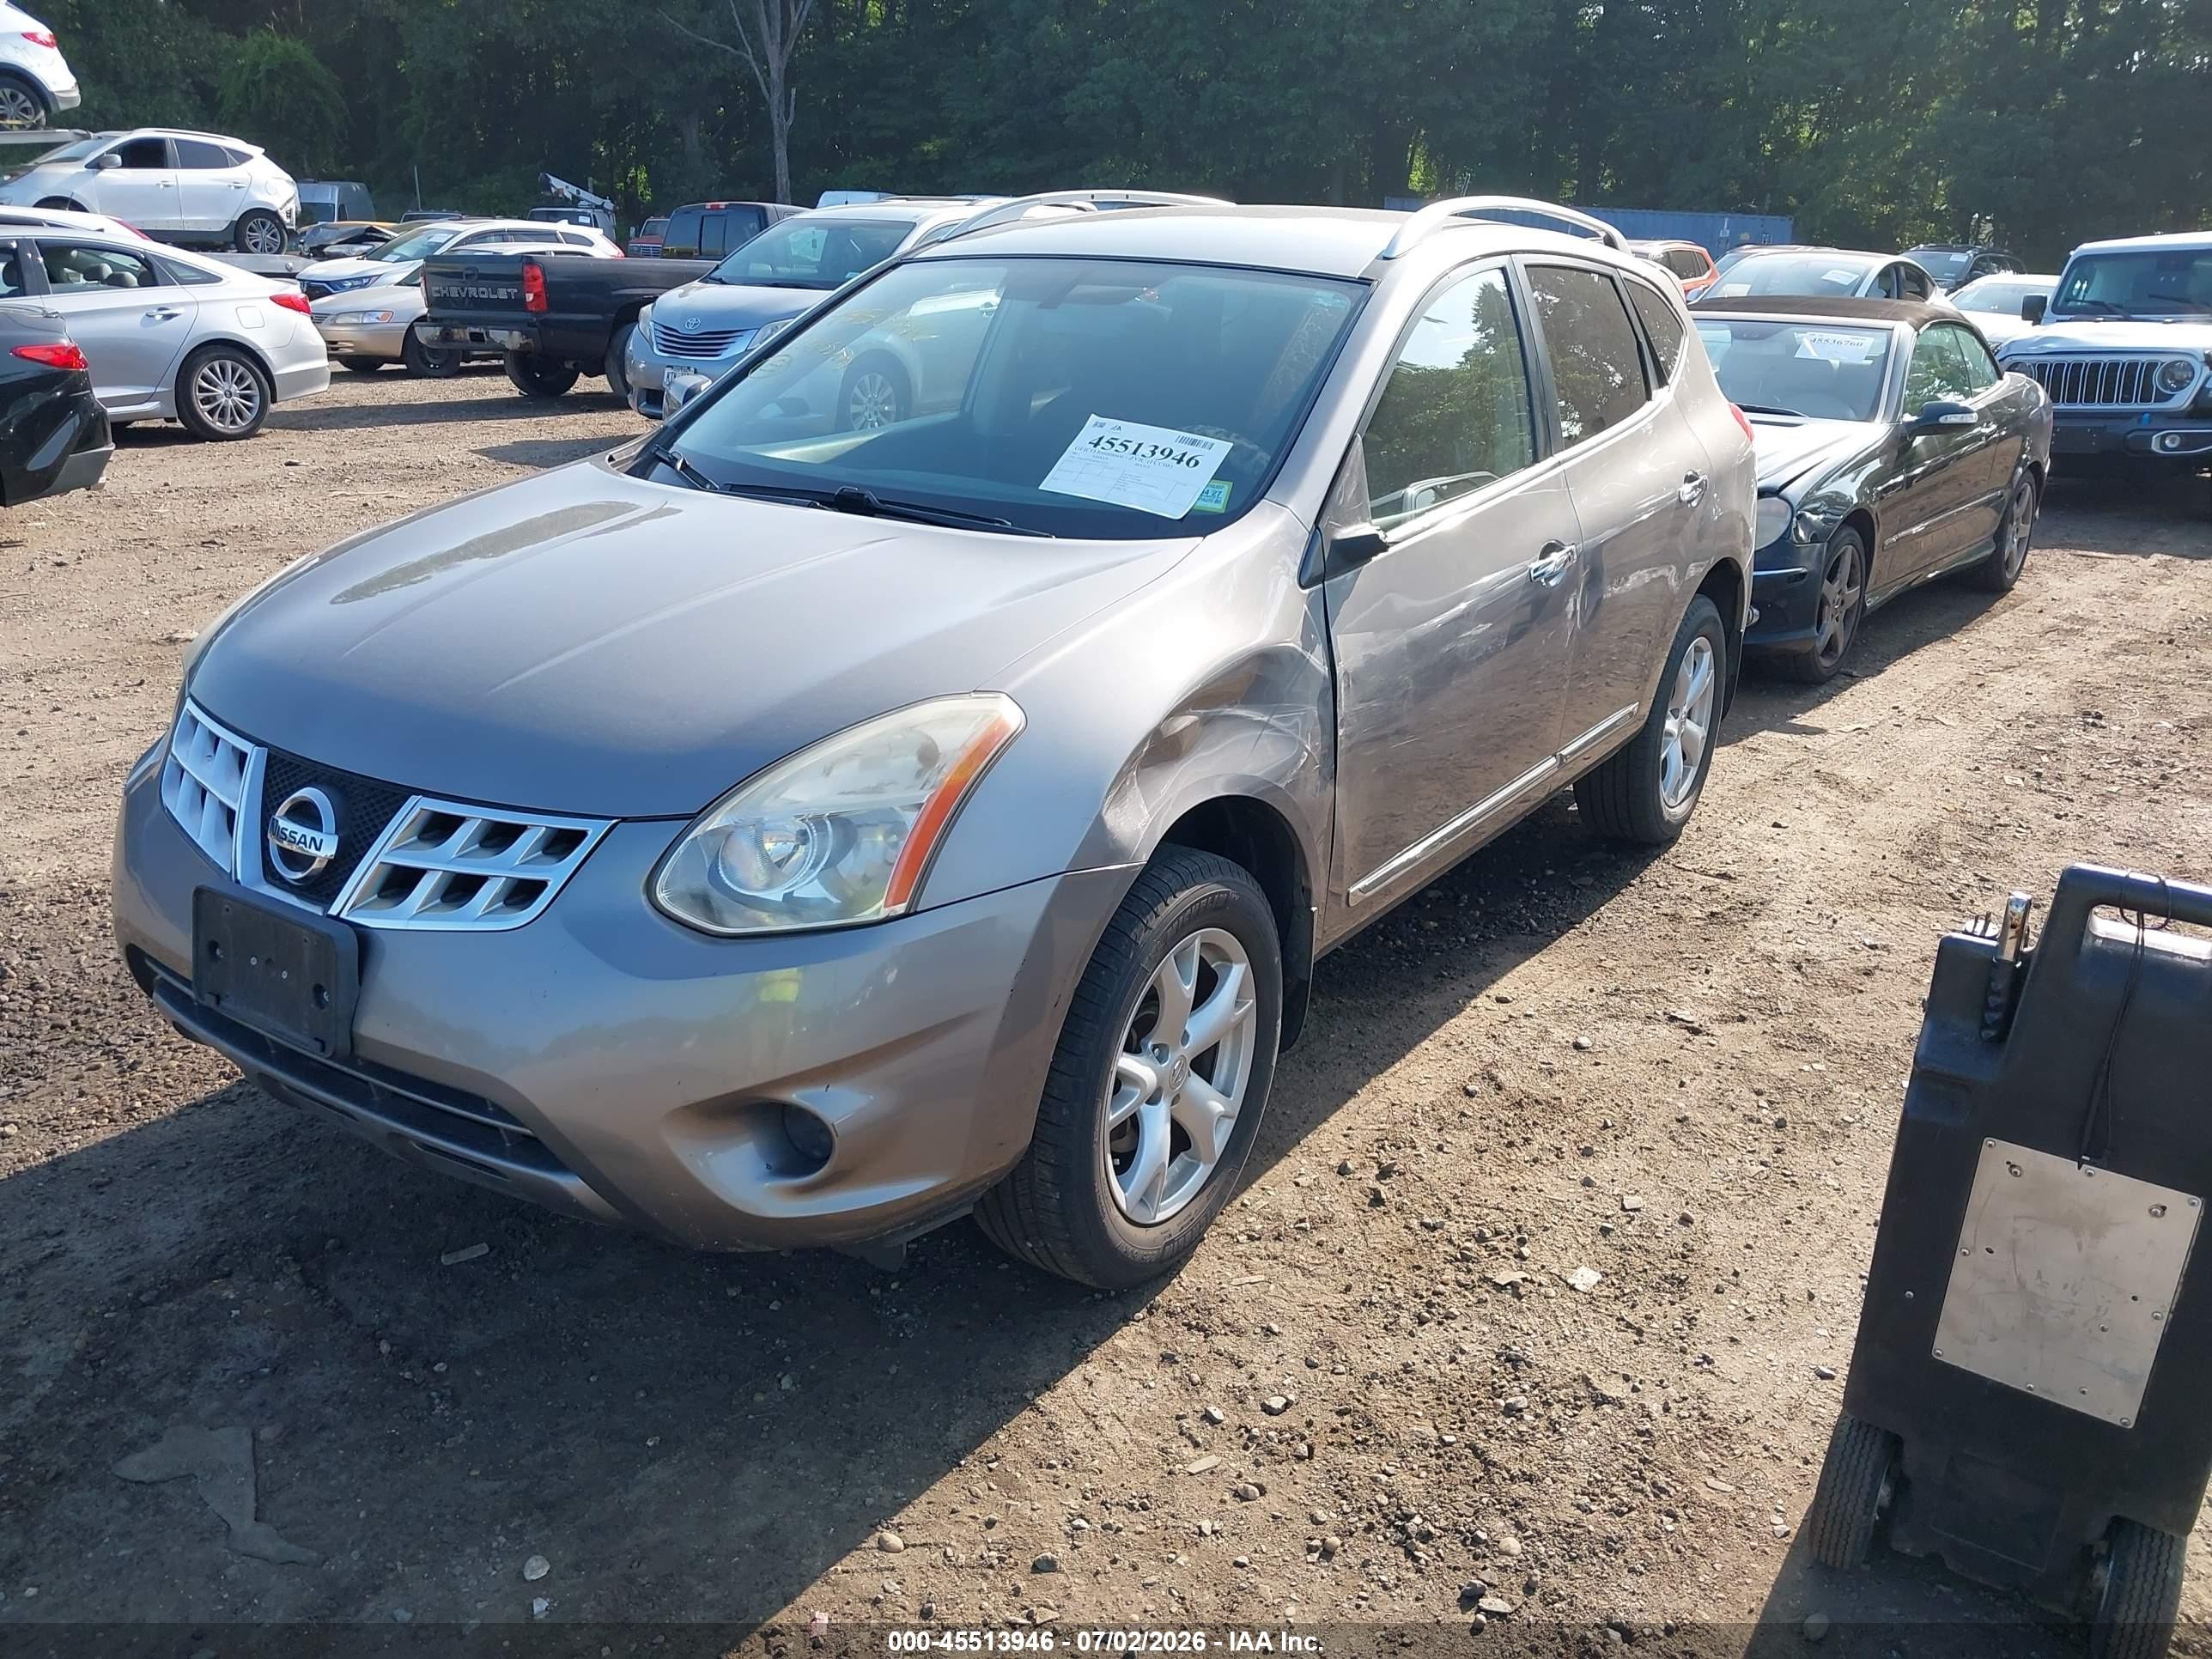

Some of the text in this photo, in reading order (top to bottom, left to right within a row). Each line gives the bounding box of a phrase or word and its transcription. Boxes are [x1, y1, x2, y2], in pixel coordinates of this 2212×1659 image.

[430, 286, 520, 300] CHEVROLET
[1088, 434, 1204, 469] 45513946
[270, 817, 324, 852] NISSAN
